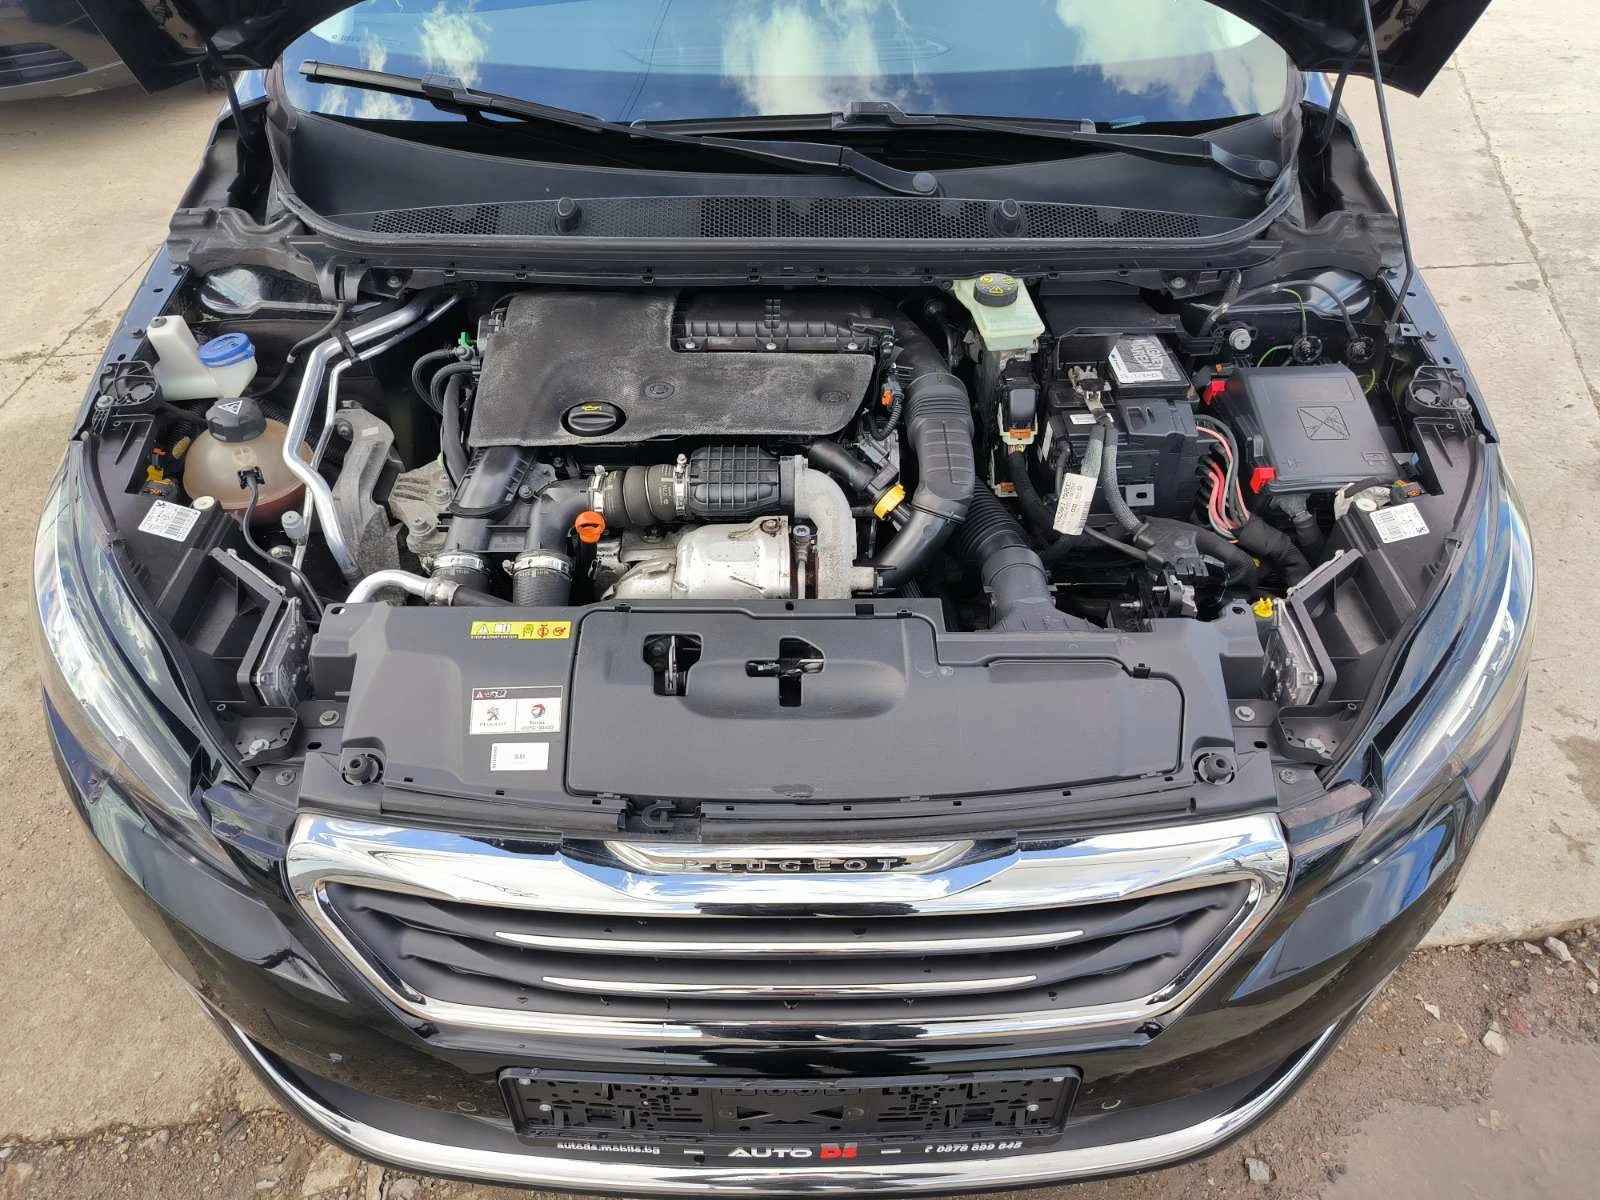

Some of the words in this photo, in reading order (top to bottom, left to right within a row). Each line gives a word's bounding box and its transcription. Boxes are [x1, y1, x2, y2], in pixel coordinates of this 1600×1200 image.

[681, 857, 898, 872] PEUGEOT
[728, 1146, 813, 1158] AUTO
[936, 1143, 969, 1153] 0878
